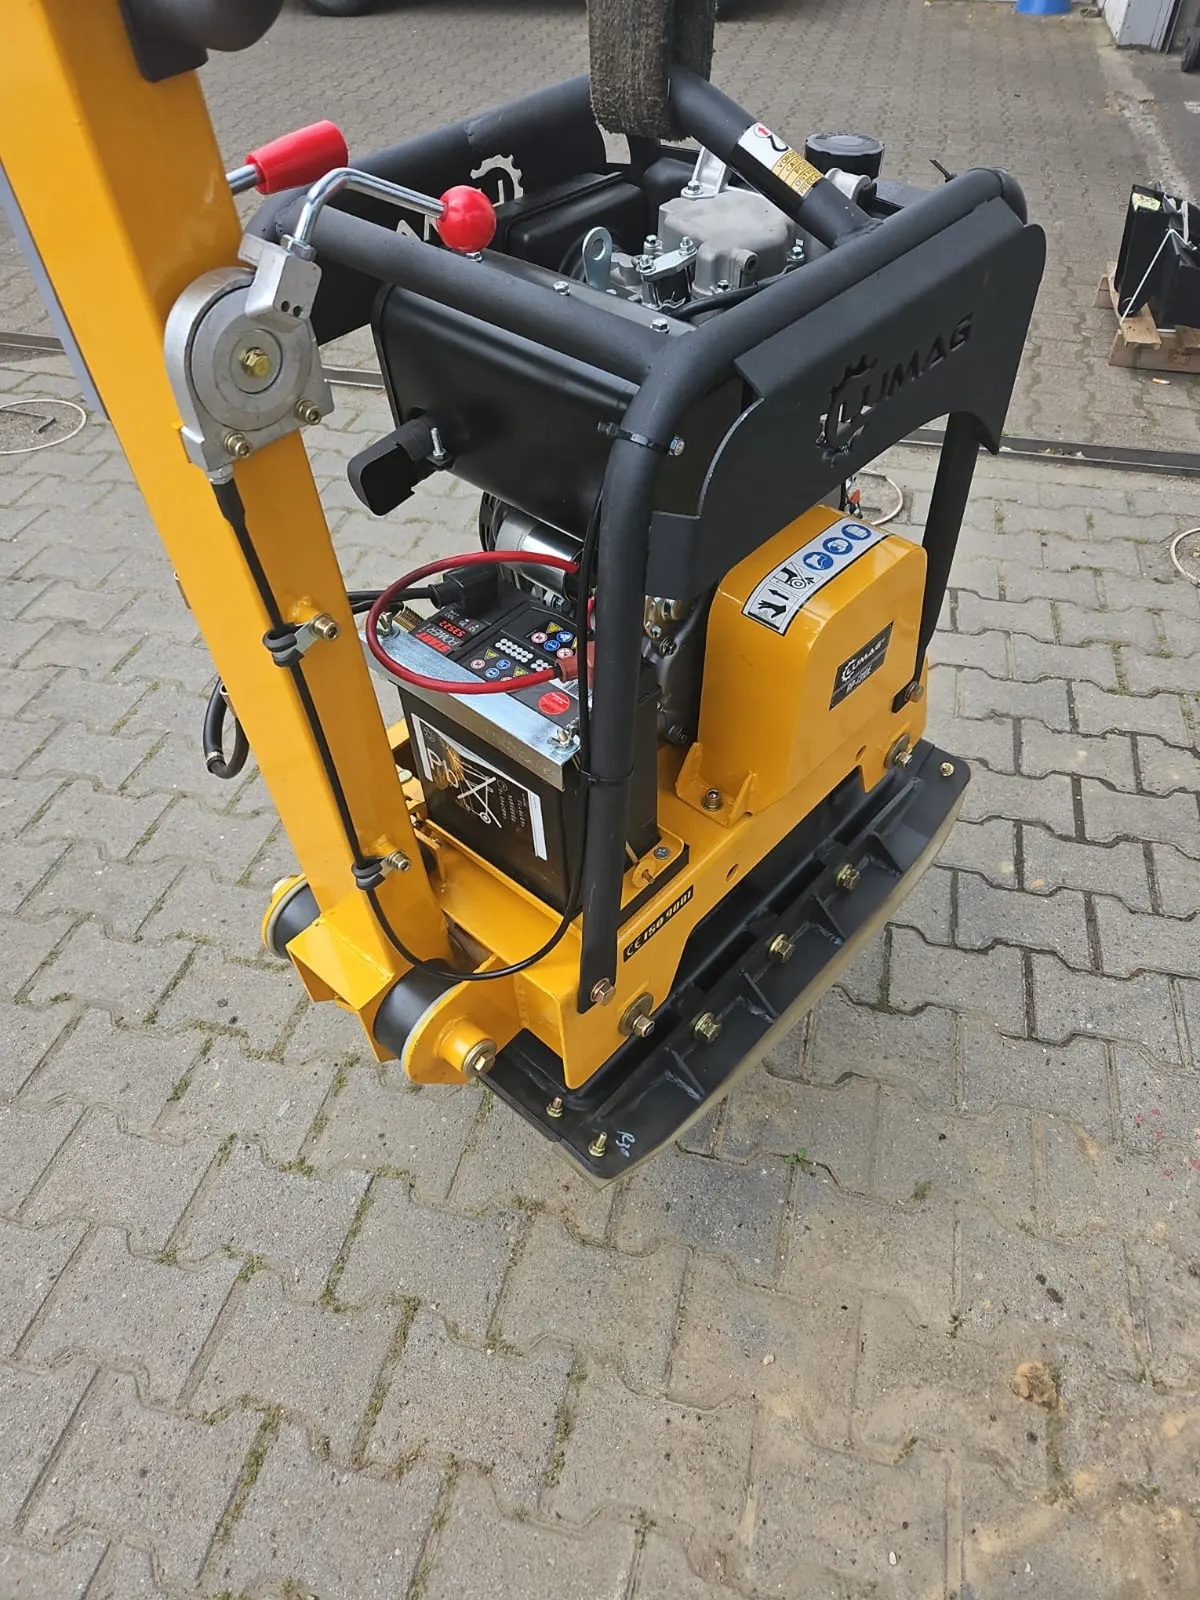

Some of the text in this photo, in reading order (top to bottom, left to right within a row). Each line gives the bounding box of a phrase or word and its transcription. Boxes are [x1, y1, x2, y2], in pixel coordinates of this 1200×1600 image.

[427, 627, 459, 646] POWER
[845, 640, 883, 675] LUMAG
[643, 917, 665, 941] ISO
[665, 890, 692, 917] 9001
